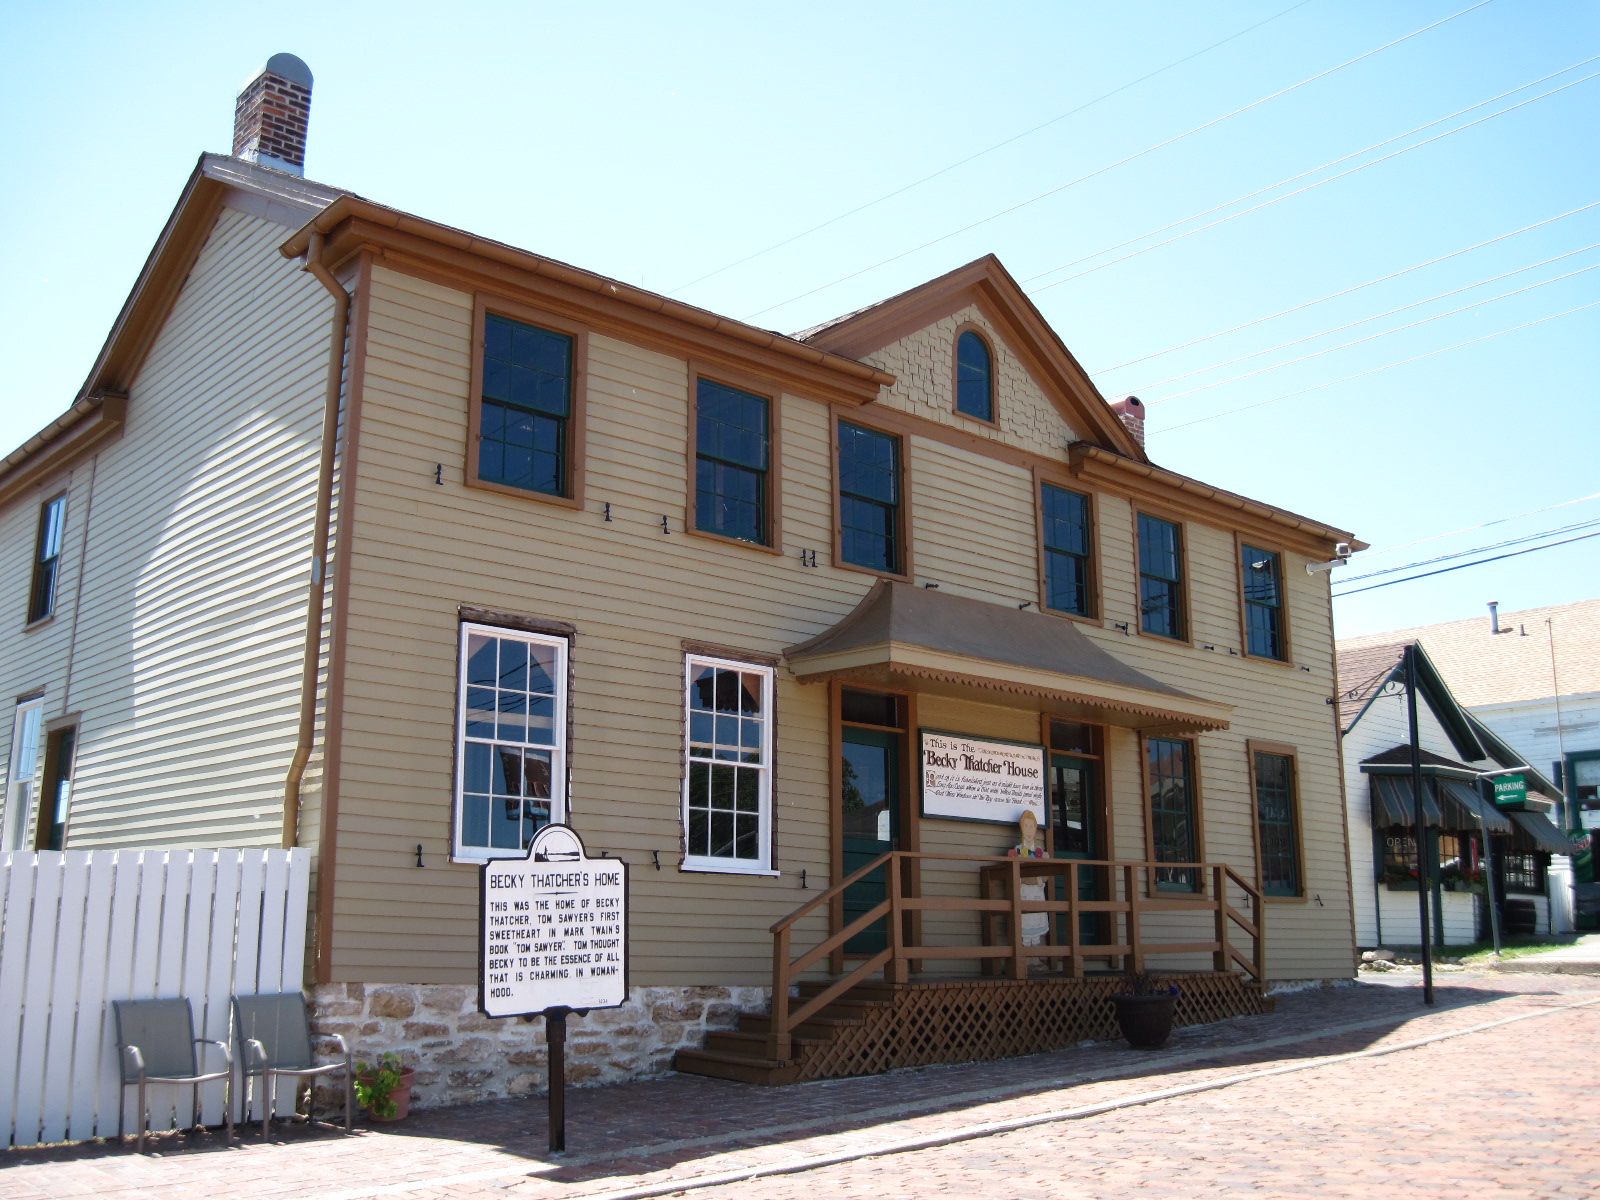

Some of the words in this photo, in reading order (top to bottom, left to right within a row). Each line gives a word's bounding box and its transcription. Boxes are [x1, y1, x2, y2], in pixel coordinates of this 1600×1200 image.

[930, 738, 947, 749] This
[950, 741, 957, 750] is
[961, 743, 975, 752] The
[923, 750, 958, 769] Becky
[959, 754, 1002, 774] Thatcher
[1003, 760, 1038, 778] House
[1495, 782, 1524, 793] PARKING
[1387, 838, 1417, 847] OPEN
[491, 874, 525, 889] BECKY
[531, 870, 589, 888] THATCHER'S
[595, 873, 620, 886] HOME
[491, 902, 507, 911] THIS
[514, 901, 529, 911] WAS
[536, 900, 549, 910] THE
[556, 900, 575, 910] HOME
[581, 899, 590, 909] OF
[596, 898, 619, 908] BECKY
[490, 915, 532, 926] THATCHER,
[538, 914, 552, 924] TOM
[559, 912, 594, 923] SAWYER'S
[601, 911, 619, 921] FIRST
[490, 929, 540, 940] SWEETHEART
[549, 928, 556, 937] IN
[564, 927, 584, 936] MARK
[592, 924, 620, 935] TWAIN'S
[490, 944, 508, 954] BOOK
[574, 940, 588, 950] TOM
[590, 939, 619, 949] THOUGHT
[490, 958, 514, 969] BECKY
[519, 958, 527, 967] TO
[531, 957, 540, 967] BE
[545, 955, 557, 965] THE
[561, 954, 591, 964] ESSENCE
[595, 953, 603, 963] OF
[607, 952, 619, 962] ALL
[490, 973, 508, 983] THAT
[516, 972, 523, 981] IS
[530, 968, 569, 980] CHARMING
[576, 968, 583, 977] IN
[591, 965, 618, 977] WOMAN-
[491, 988, 513, 998] HOOD.
